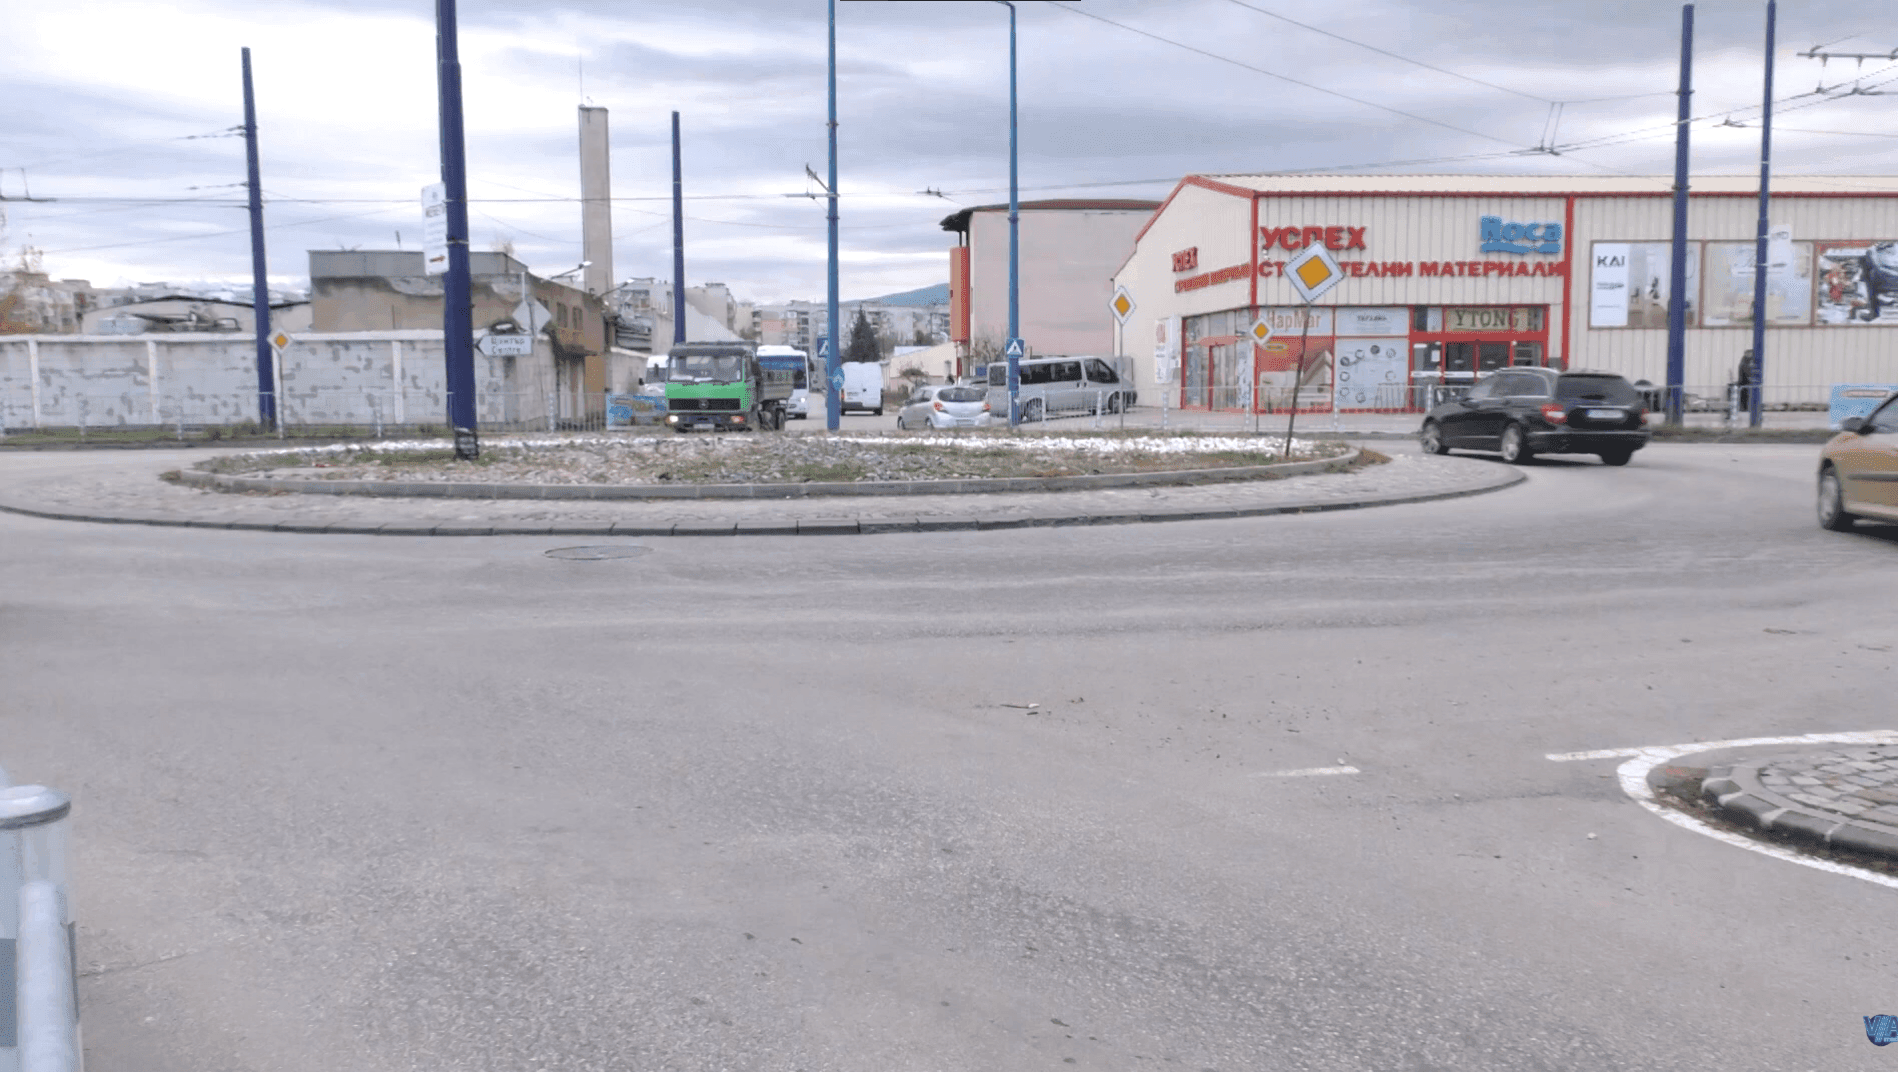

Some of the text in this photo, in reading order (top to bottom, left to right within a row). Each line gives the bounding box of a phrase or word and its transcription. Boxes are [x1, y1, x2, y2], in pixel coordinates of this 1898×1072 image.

[1260, 226, 1366, 250] УСПЕХ
[1258, 261, 1566, 277] СТТЕЛНИ МАТЕРИАЛИ
[1597, 255, 1625, 267] KAI
